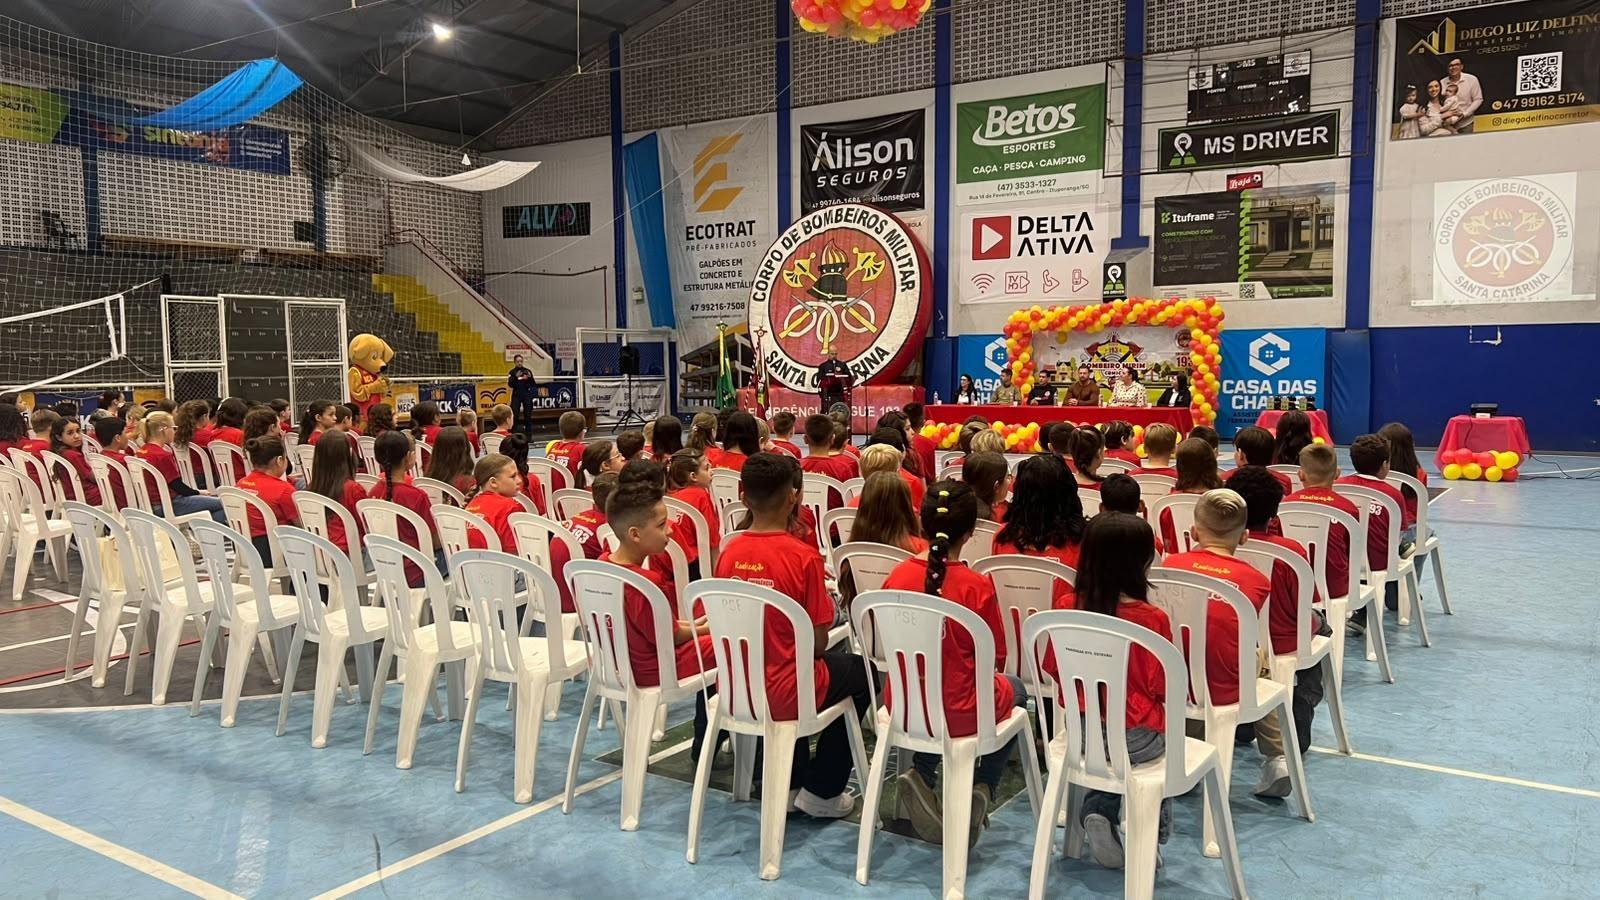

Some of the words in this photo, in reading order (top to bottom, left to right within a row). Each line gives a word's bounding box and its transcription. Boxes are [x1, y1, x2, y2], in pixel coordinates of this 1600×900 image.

[1460, 26, 1504, 40] DIEGO
[1507, 21, 1540, 34] LUIZ
[1503, 99, 1518, 109] 47
[1521, 95, 1555, 108] 99162
[1558, 92, 1585, 104] 5174
[1503, 110, 1590, 125] diegodelfinocorretor
[1003, 140, 1056, 154] ESPORTES
[1204, 135, 1235, 155] MS
[1243, 126, 1329, 152] DRIVER
[811, 131, 914, 172] Álison
[973, 164, 998, 175] CAÇA
[1004, 160, 1034, 171] PESCA
[1040, 155, 1086, 168] CAMPING
[817, 166, 907, 188] SEGUROS
[997, 182, 1013, 192] (47)
[1015, 179, 1057, 190] 3533-1327
[1172, 213, 1215, 223] Ituframe
[1439, 209, 1460, 246] CORPO
[1458, 195, 1475, 210] DE
[1474, 183, 1544, 201] BOMBEIROS
[1542, 197, 1569, 239] MILITAR
[685, 220, 756, 241] ECOTRAT
[1017, 212, 1094, 235] DELTA
[686, 240, 757, 252] PRÉ-FABRICADOS
[1017, 234, 1094, 257] ATIVA
[699, 258, 730, 268] GALPÕES
[732, 259, 743, 267] EM
[753, 250, 783, 303] CORPO
[782, 230, 802, 251] DE
[801, 207, 889, 236] BOMBEIROS
[883, 228, 916, 292] MILITAR
[700, 270, 736, 280] CONCRETO
[683, 282, 723, 291] ESTRUTURA
[725, 281, 754, 290] METÁLI
[1454, 275, 1490, 299] SANTA
[1492, 272, 1550, 299] CATARINA
[690, 304, 699, 312] 47
[701, 302, 745, 311] 99216-7508
[765, 350, 806, 387] SANTA
[974, 378, 1002, 391] ASA
[1222, 379, 1272, 394] CASA
[1278, 379, 1317, 394] DAS
[851, 405, 876, 417] GUE
[1369, 504, 1383, 516] 93
